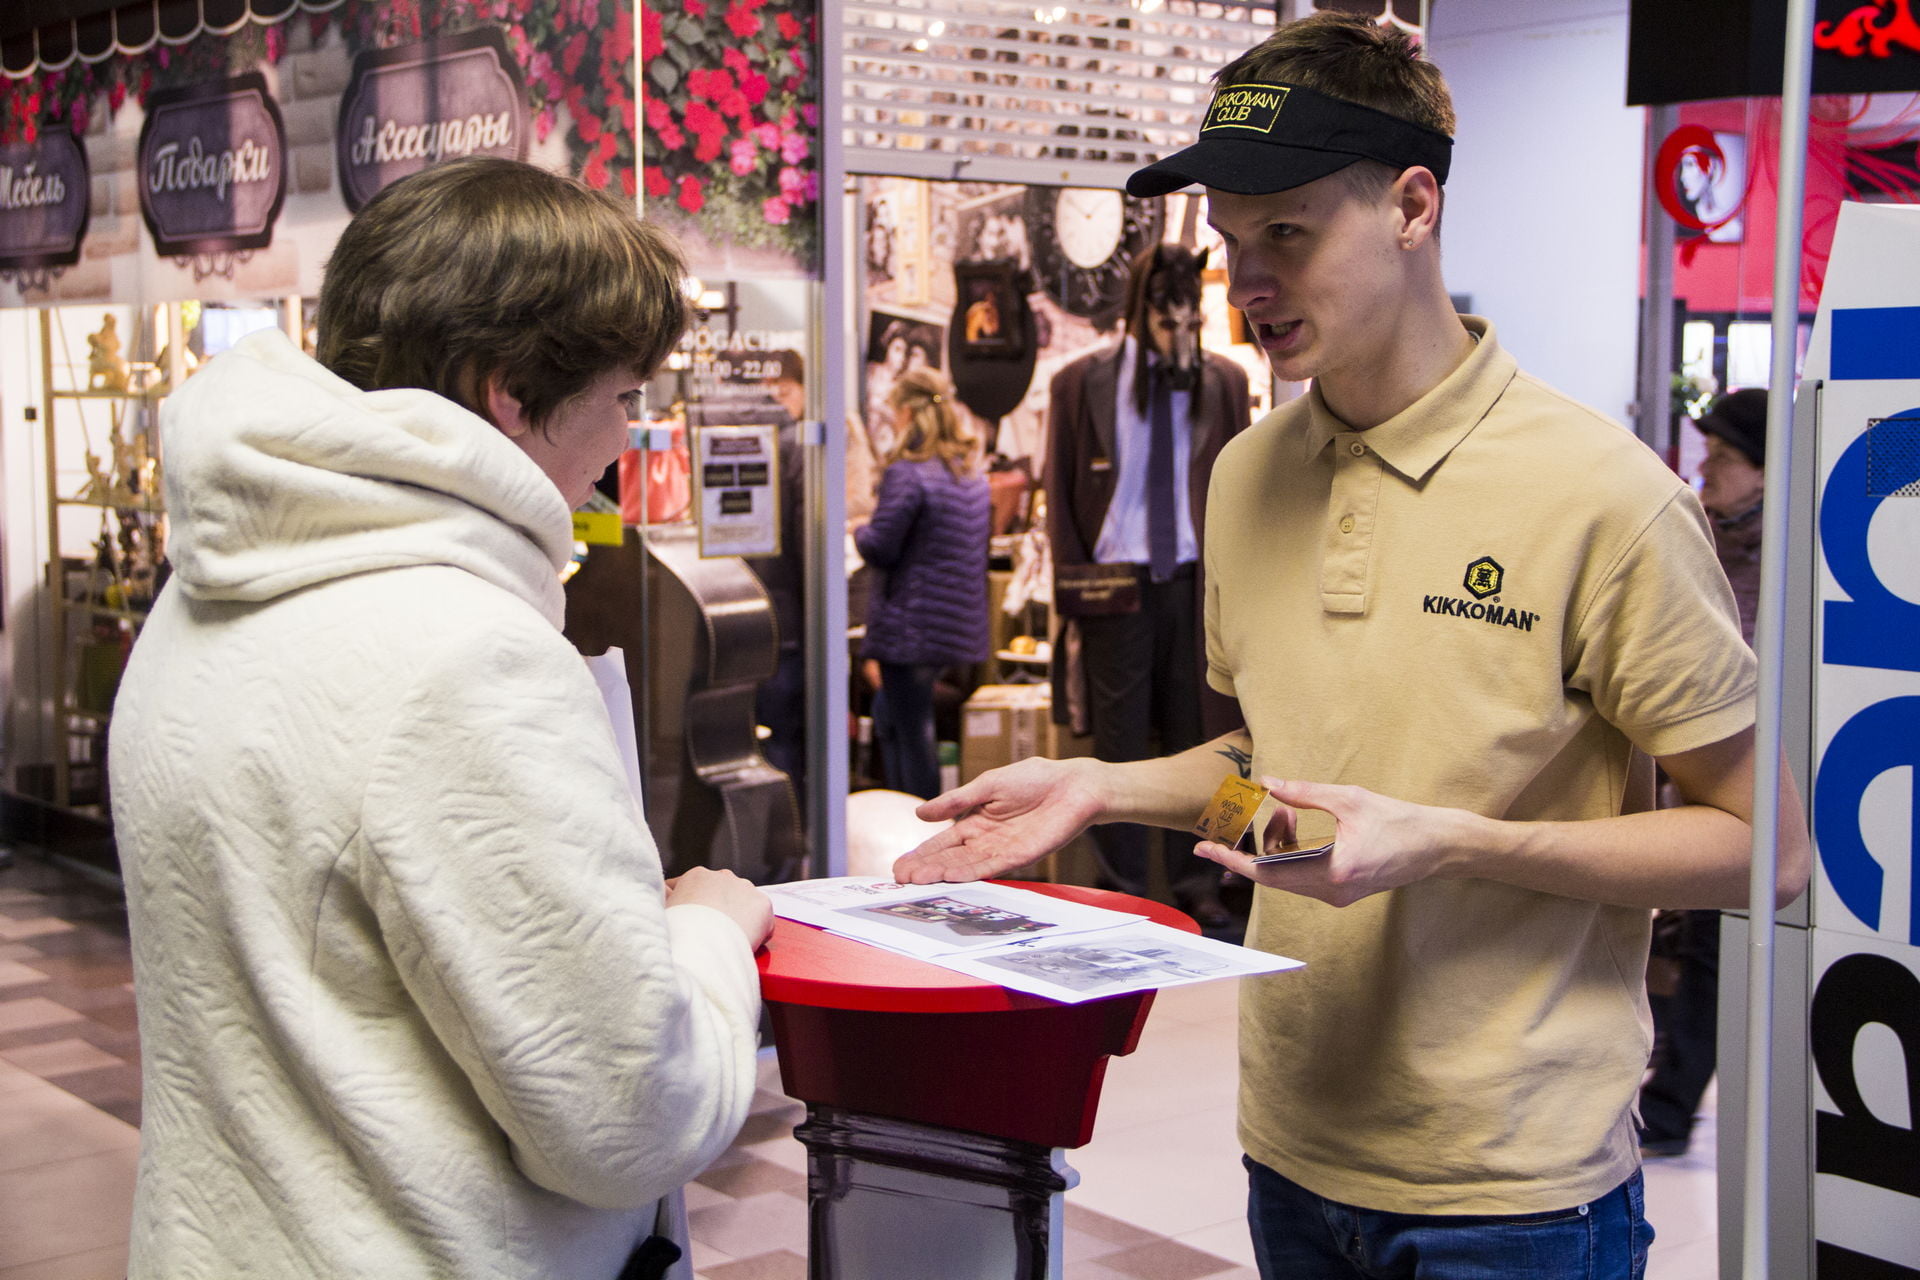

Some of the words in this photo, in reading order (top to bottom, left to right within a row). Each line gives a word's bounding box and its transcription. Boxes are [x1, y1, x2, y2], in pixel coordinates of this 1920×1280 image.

[1215, 91, 1280, 110] KIKKOMAN
[1217, 106, 1251, 122] CLUB
[149, 135, 270, 201] Подарки
